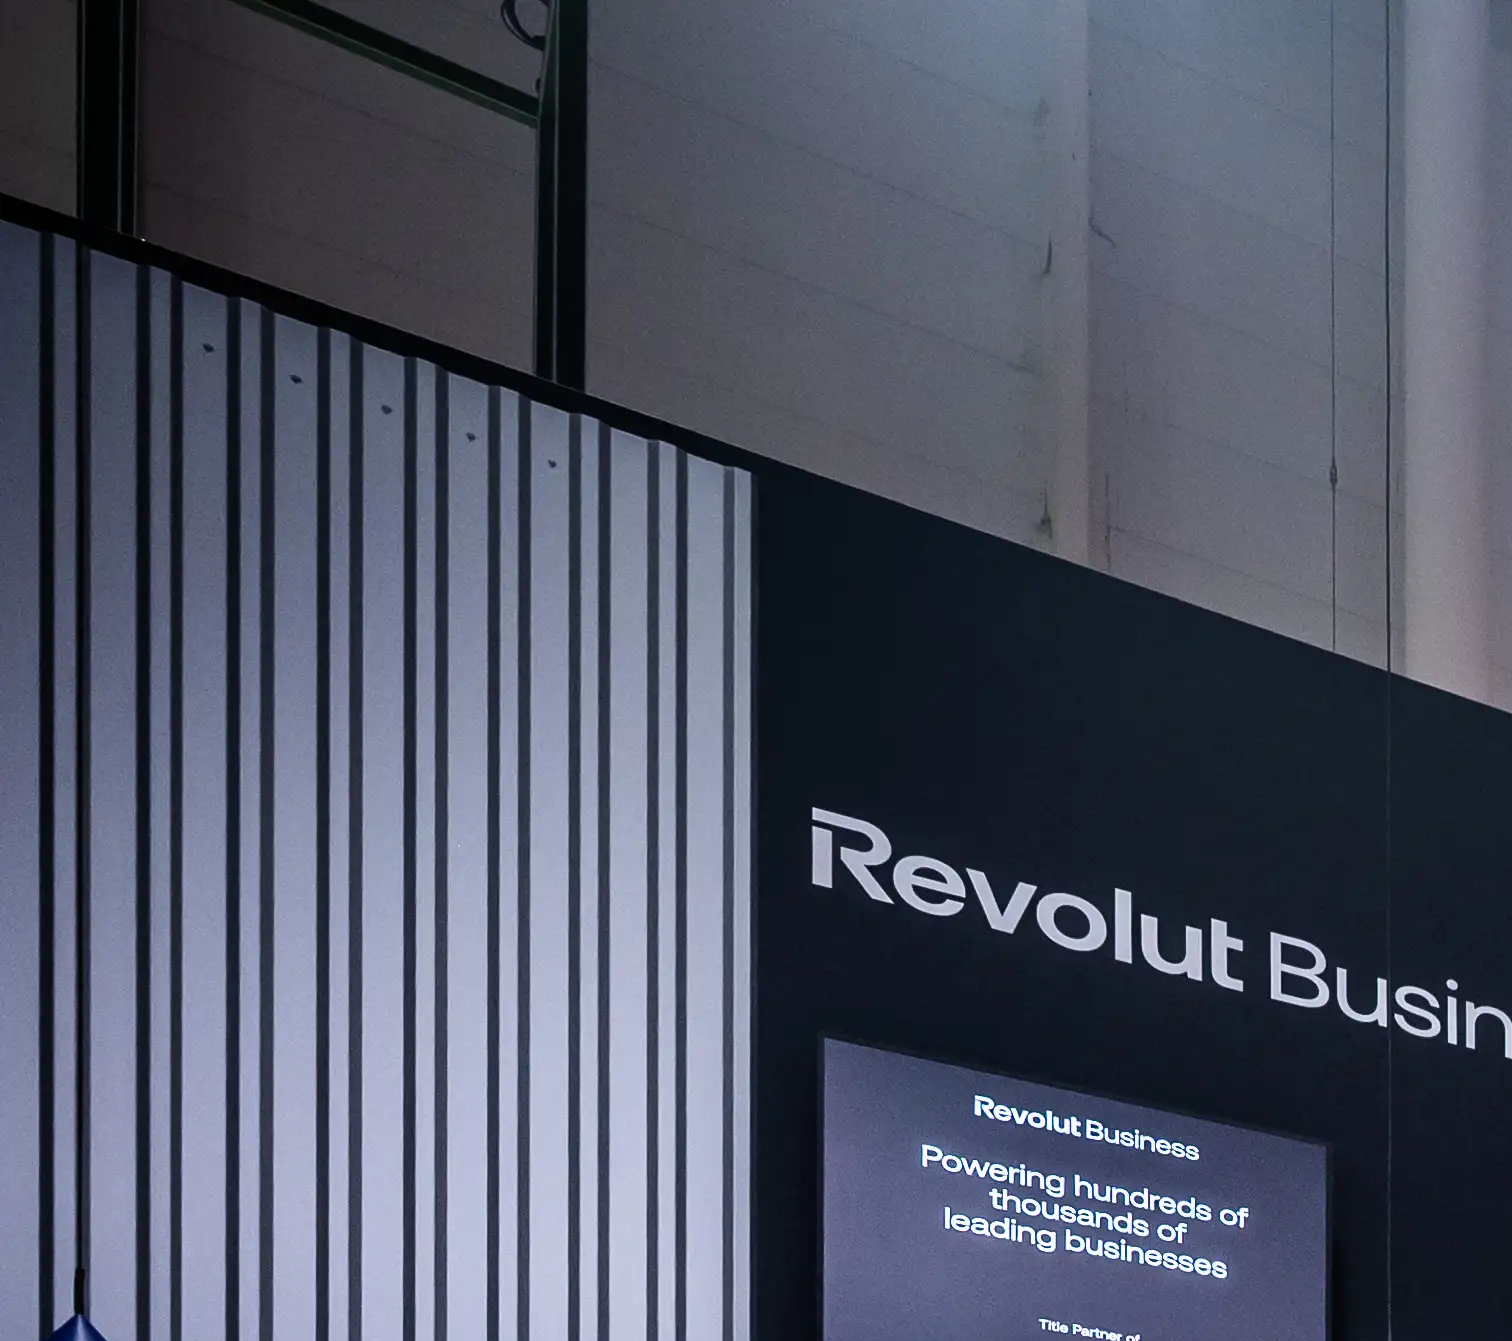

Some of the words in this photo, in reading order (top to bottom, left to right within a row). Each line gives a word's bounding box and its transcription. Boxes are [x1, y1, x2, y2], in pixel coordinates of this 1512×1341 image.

[811, 806, 1244, 992] Revolut
[973, 1094, 1082, 1137] Revolut
[1085, 1120, 1200, 1161] Business
[920, 1144, 1065, 1198] Powering
[1074, 1174, 1212, 1222] hundreds
[1218, 1207, 1249, 1229] of
[988, 1188, 1149, 1237] thousands
[1156, 1222, 1188, 1244] of
[944, 1207, 1057, 1252] leading
[1065, 1229, 1228, 1279] businesses
[1038, 1317, 1068, 1334] Title
[1072, 1323, 1123, 1341] Partner
